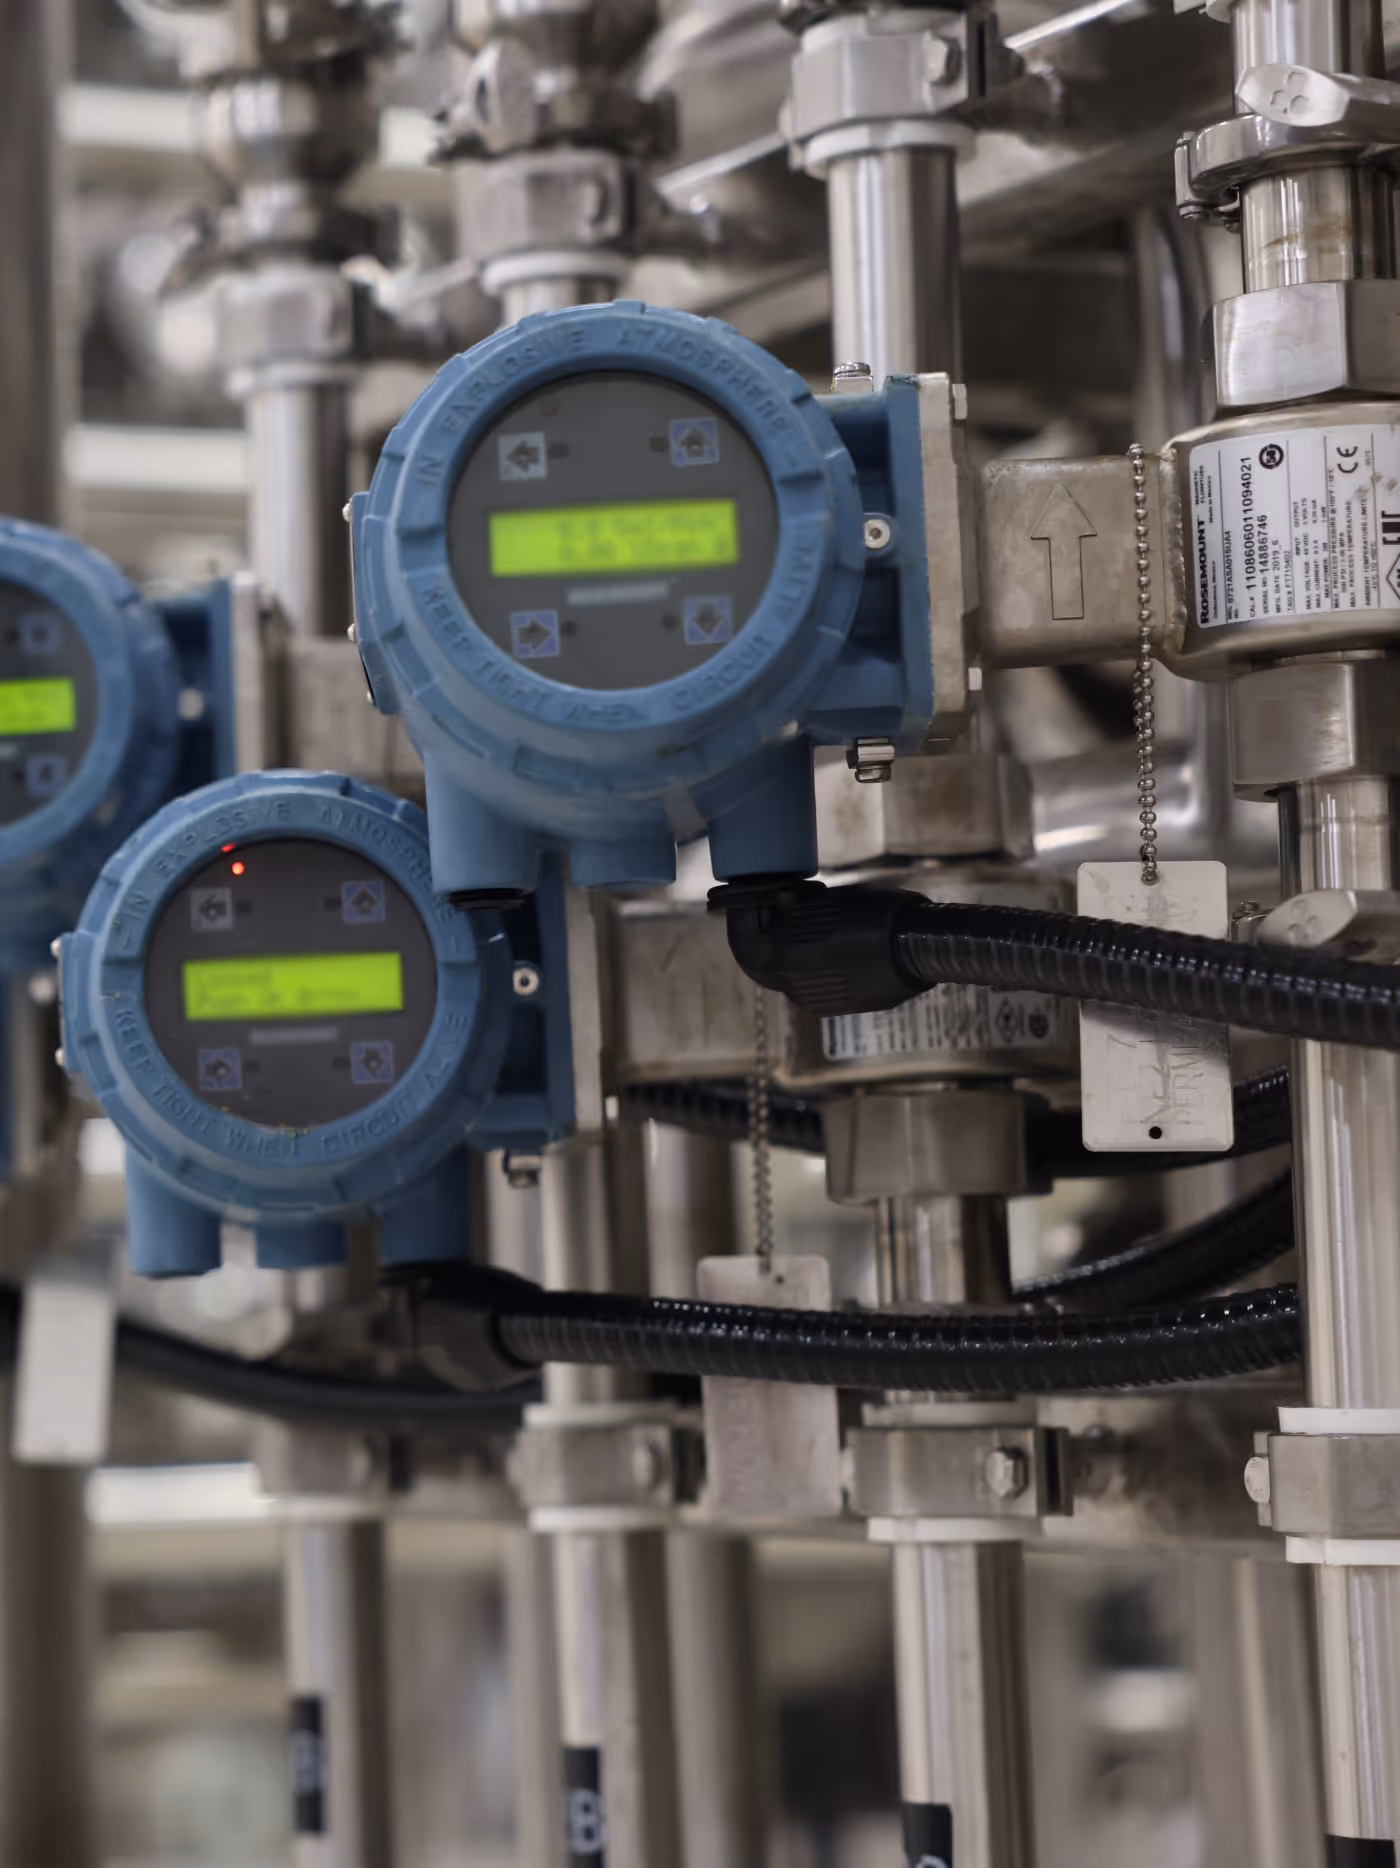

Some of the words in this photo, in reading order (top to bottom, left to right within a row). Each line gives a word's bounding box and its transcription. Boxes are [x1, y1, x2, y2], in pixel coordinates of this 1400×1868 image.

[1336, 446, 1359, 474] CE
[1240, 457, 1257, 590] 1108606011094021
[1257, 514, 1270, 574] 14886746
[1197, 517, 1209, 625] ROSEMOUNT
